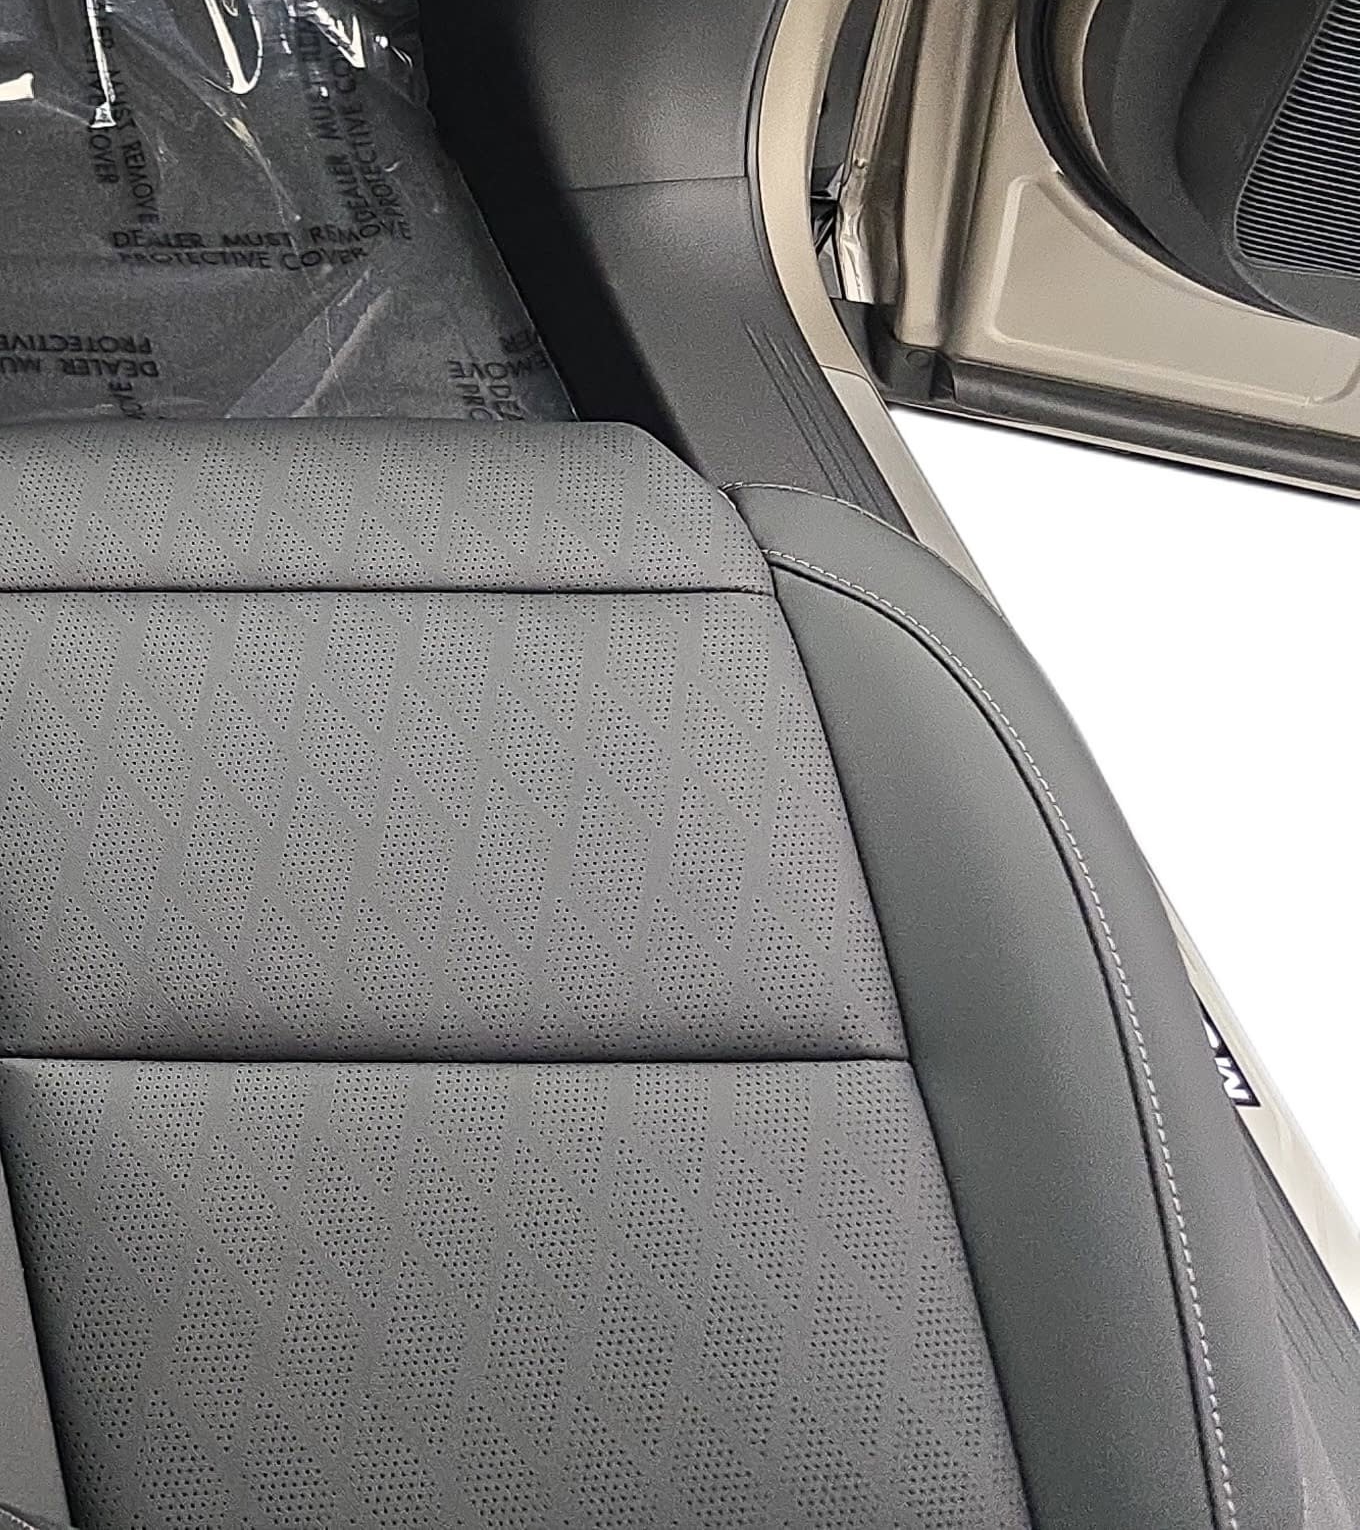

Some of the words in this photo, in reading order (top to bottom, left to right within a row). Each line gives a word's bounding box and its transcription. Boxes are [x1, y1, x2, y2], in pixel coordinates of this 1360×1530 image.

[111, 230, 206, 250] DEALER
[222, 230, 294, 249] MUST
[309, 221, 413, 248] REMOVE
[118, 249, 271, 270] PROTECTIVE
[282, 246, 370, 272] COVER
[59, 356, 160, 379] DEALER
